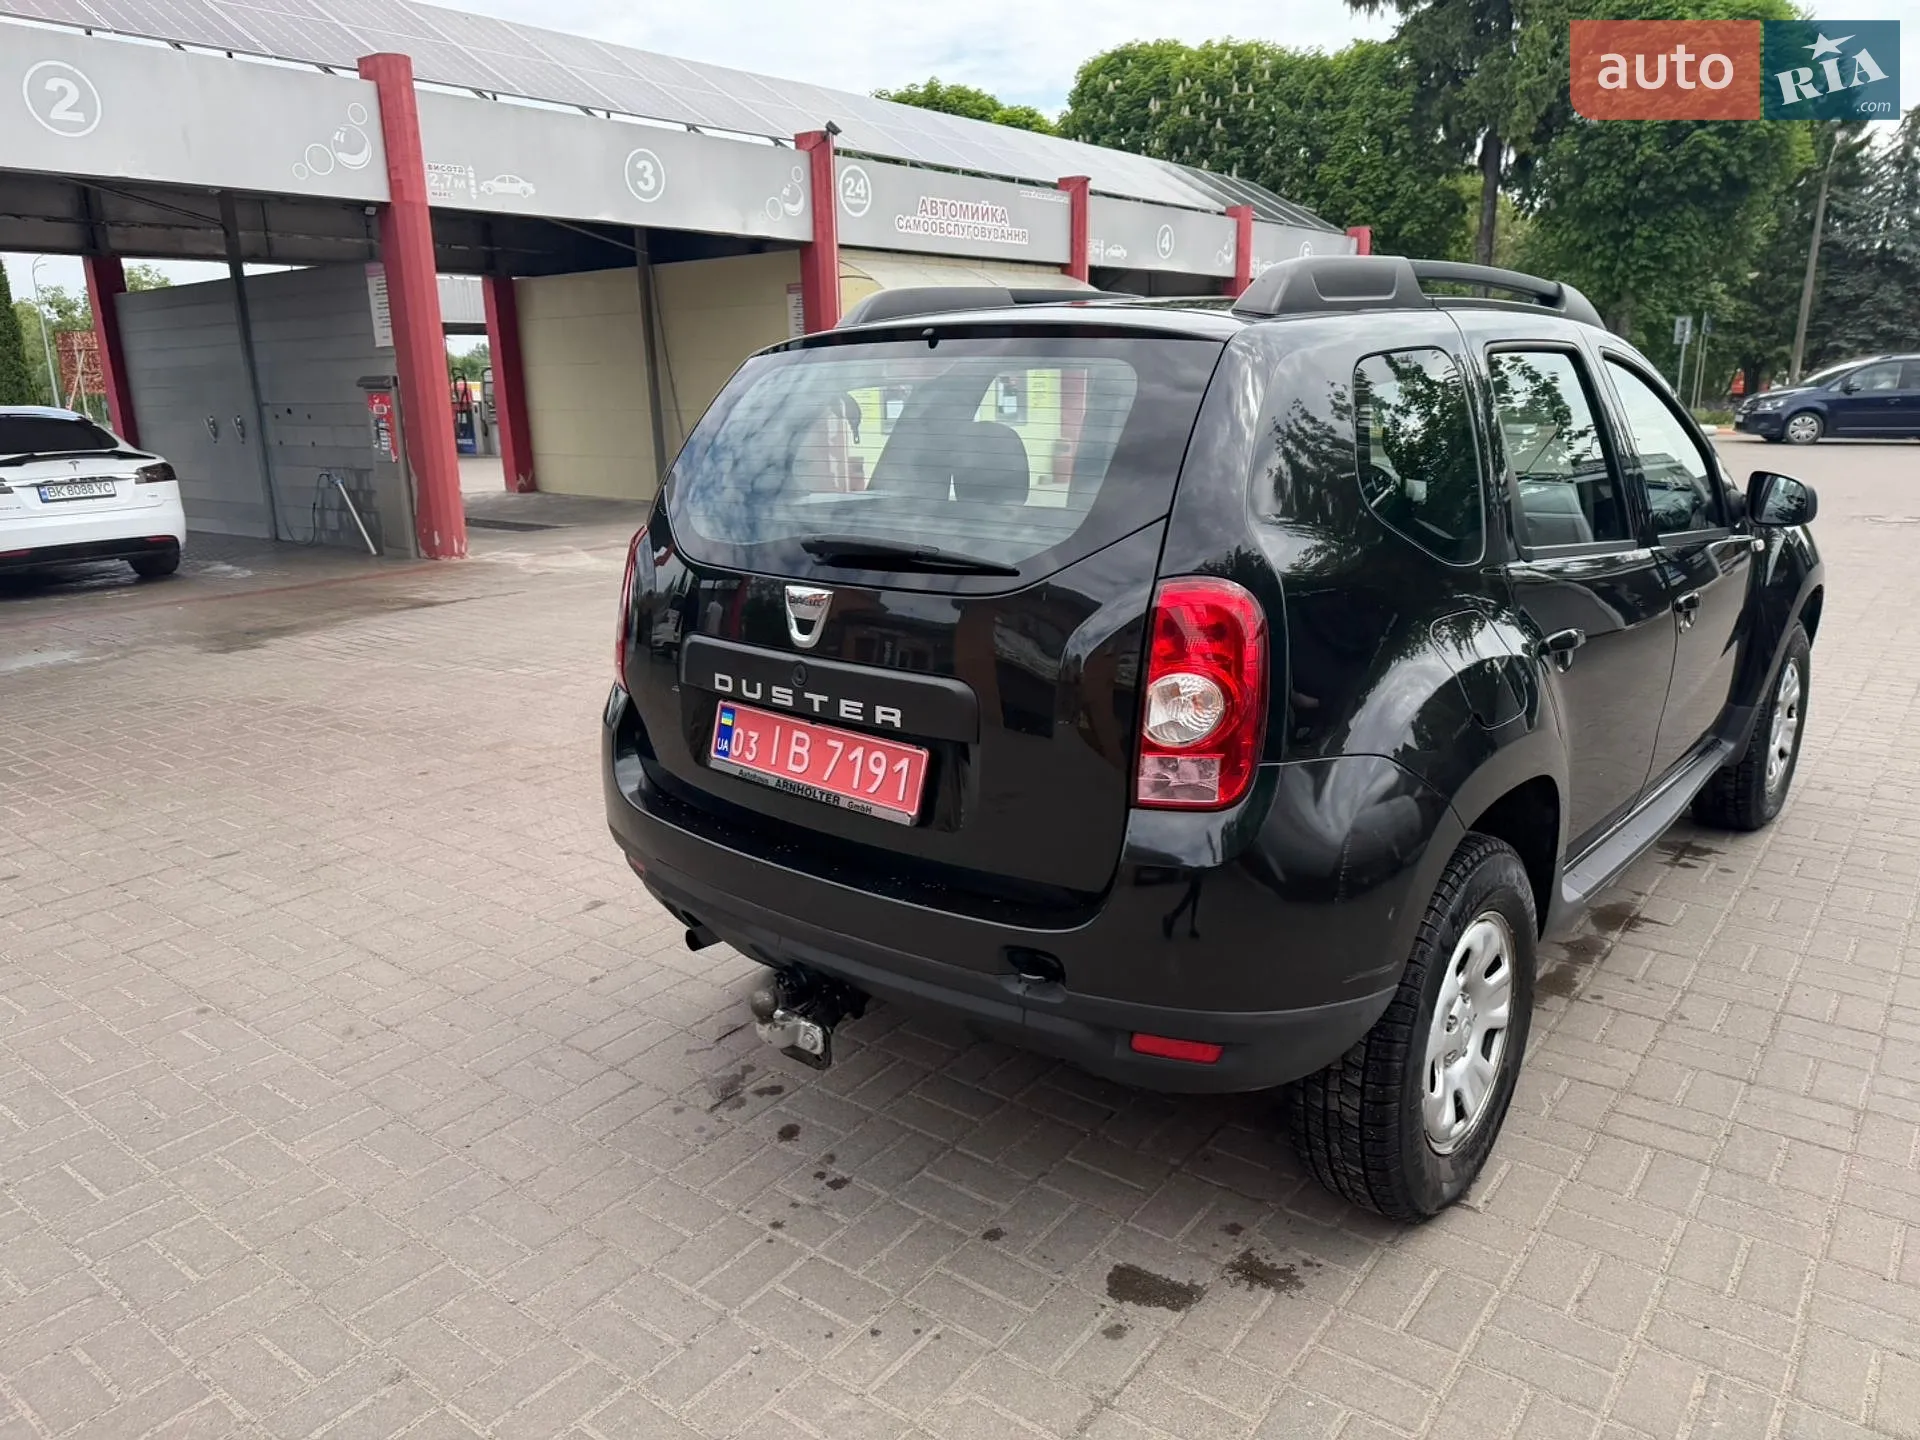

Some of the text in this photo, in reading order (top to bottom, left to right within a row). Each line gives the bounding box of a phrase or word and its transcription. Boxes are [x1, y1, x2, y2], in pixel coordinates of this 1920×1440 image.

[45, 77, 85, 123] 2
[636, 159, 656, 192] 3
[844, 177, 866, 197] 24
[918, 197, 1009, 226] АВТОМИЙКА
[896, 216, 1028, 243] САМООБСЛУГОВУВАННЯ
[1161, 231, 1170, 252] 4
[714, 672, 903, 728] DUSTER
[717, 736, 729, 752] UA
[732, 725, 911, 802] 03 IB 7191
[775, 778, 842, 807] ARNHOLTER
[847, 800, 873, 815] GmbH
